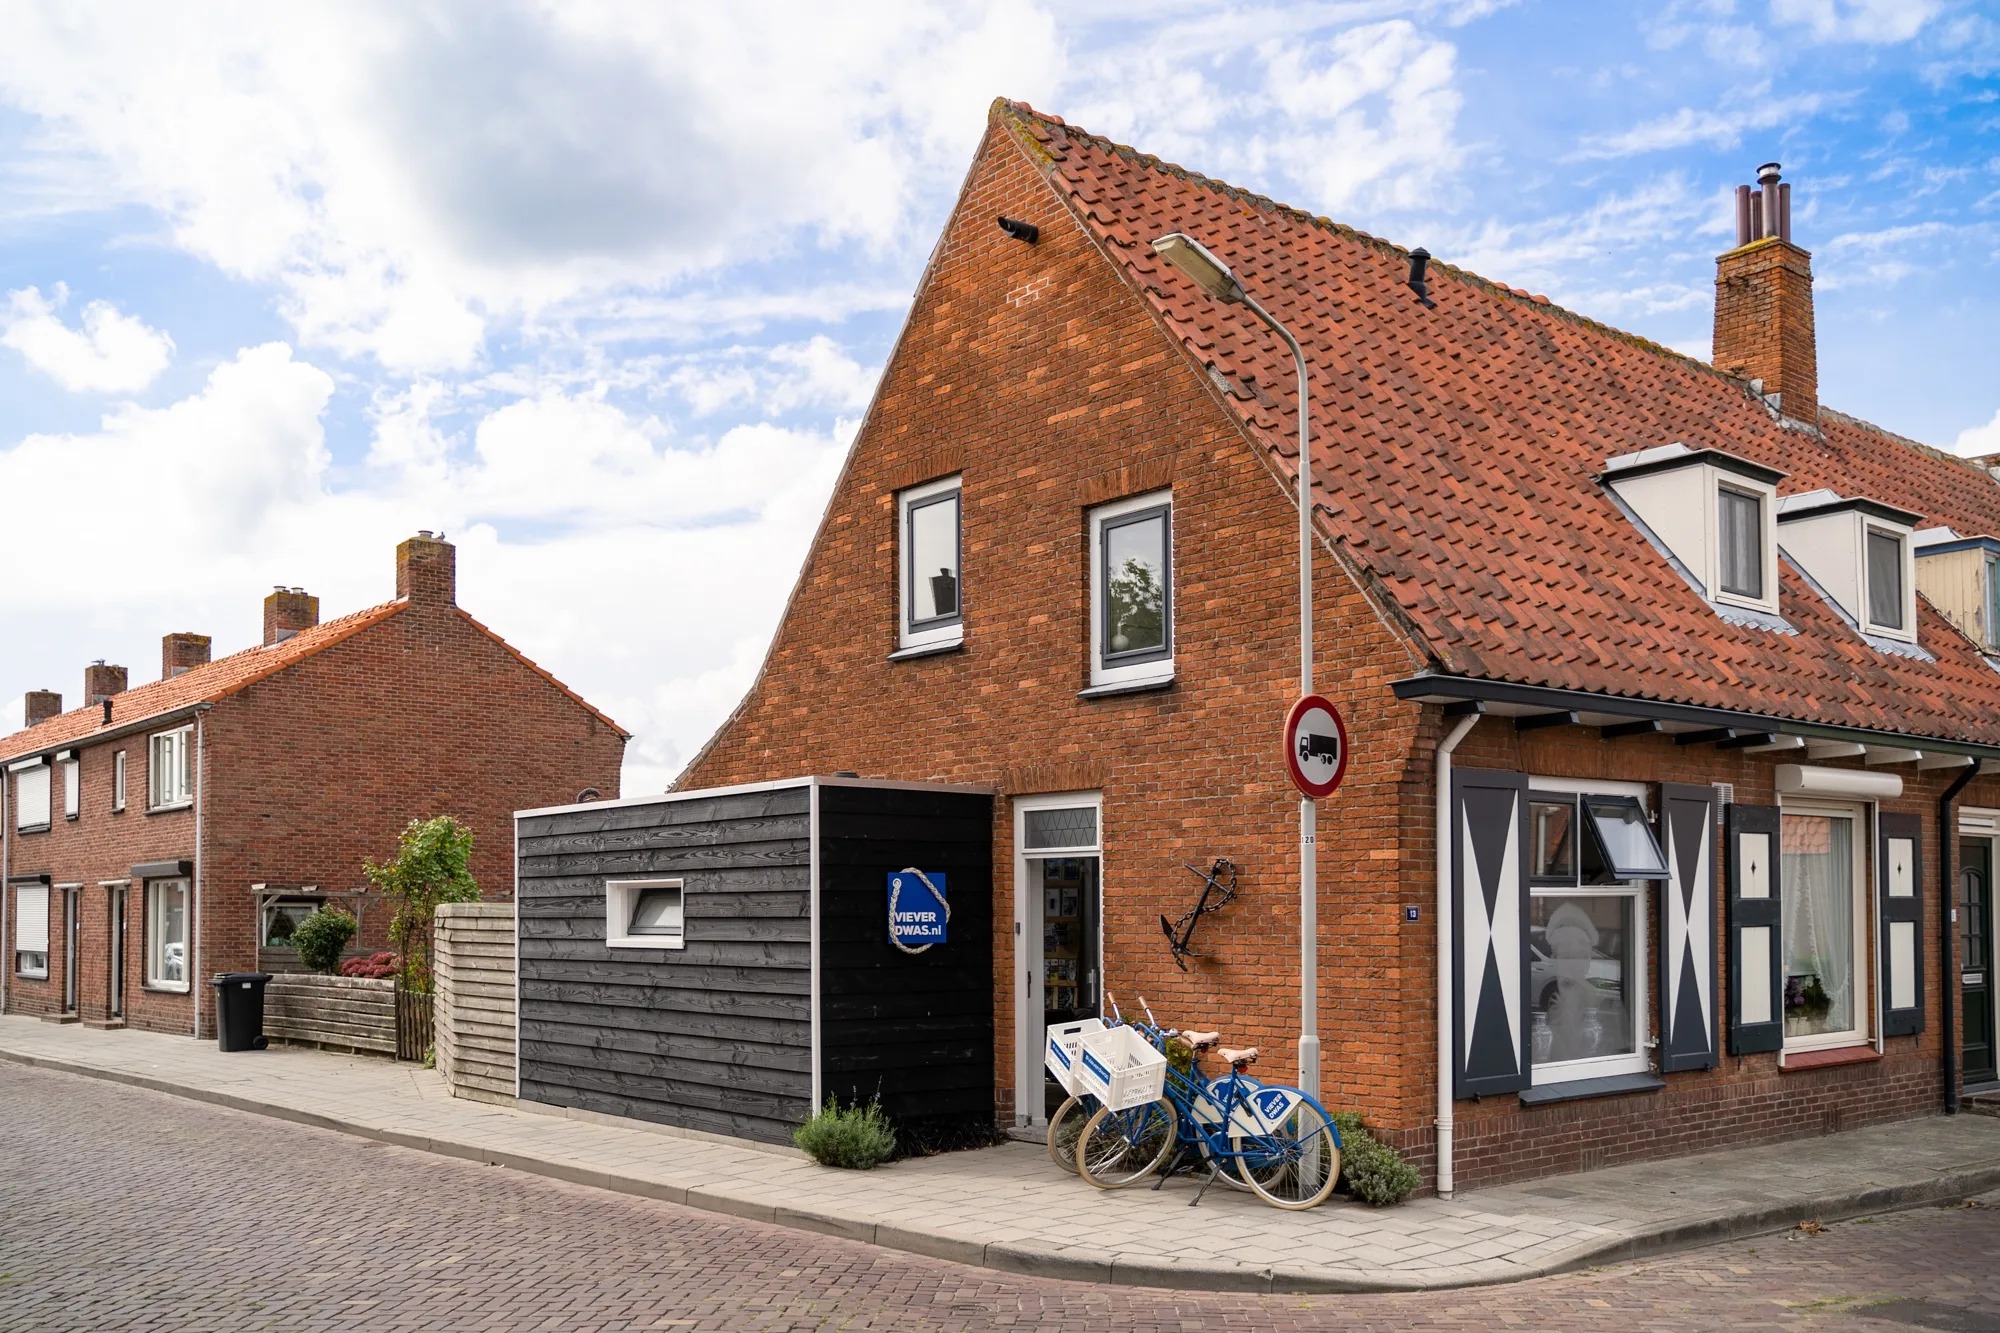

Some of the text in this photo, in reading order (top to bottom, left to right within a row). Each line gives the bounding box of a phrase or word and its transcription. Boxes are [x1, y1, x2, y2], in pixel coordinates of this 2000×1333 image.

[894, 911, 937, 923] VIEVER
[1409, 910, 1417, 918] 13
[894, 925, 941, 936] DWAS.nl
[1264, 1093, 1283, 1113] VIEVER
[1269, 1101, 1284, 1119] DWAS
